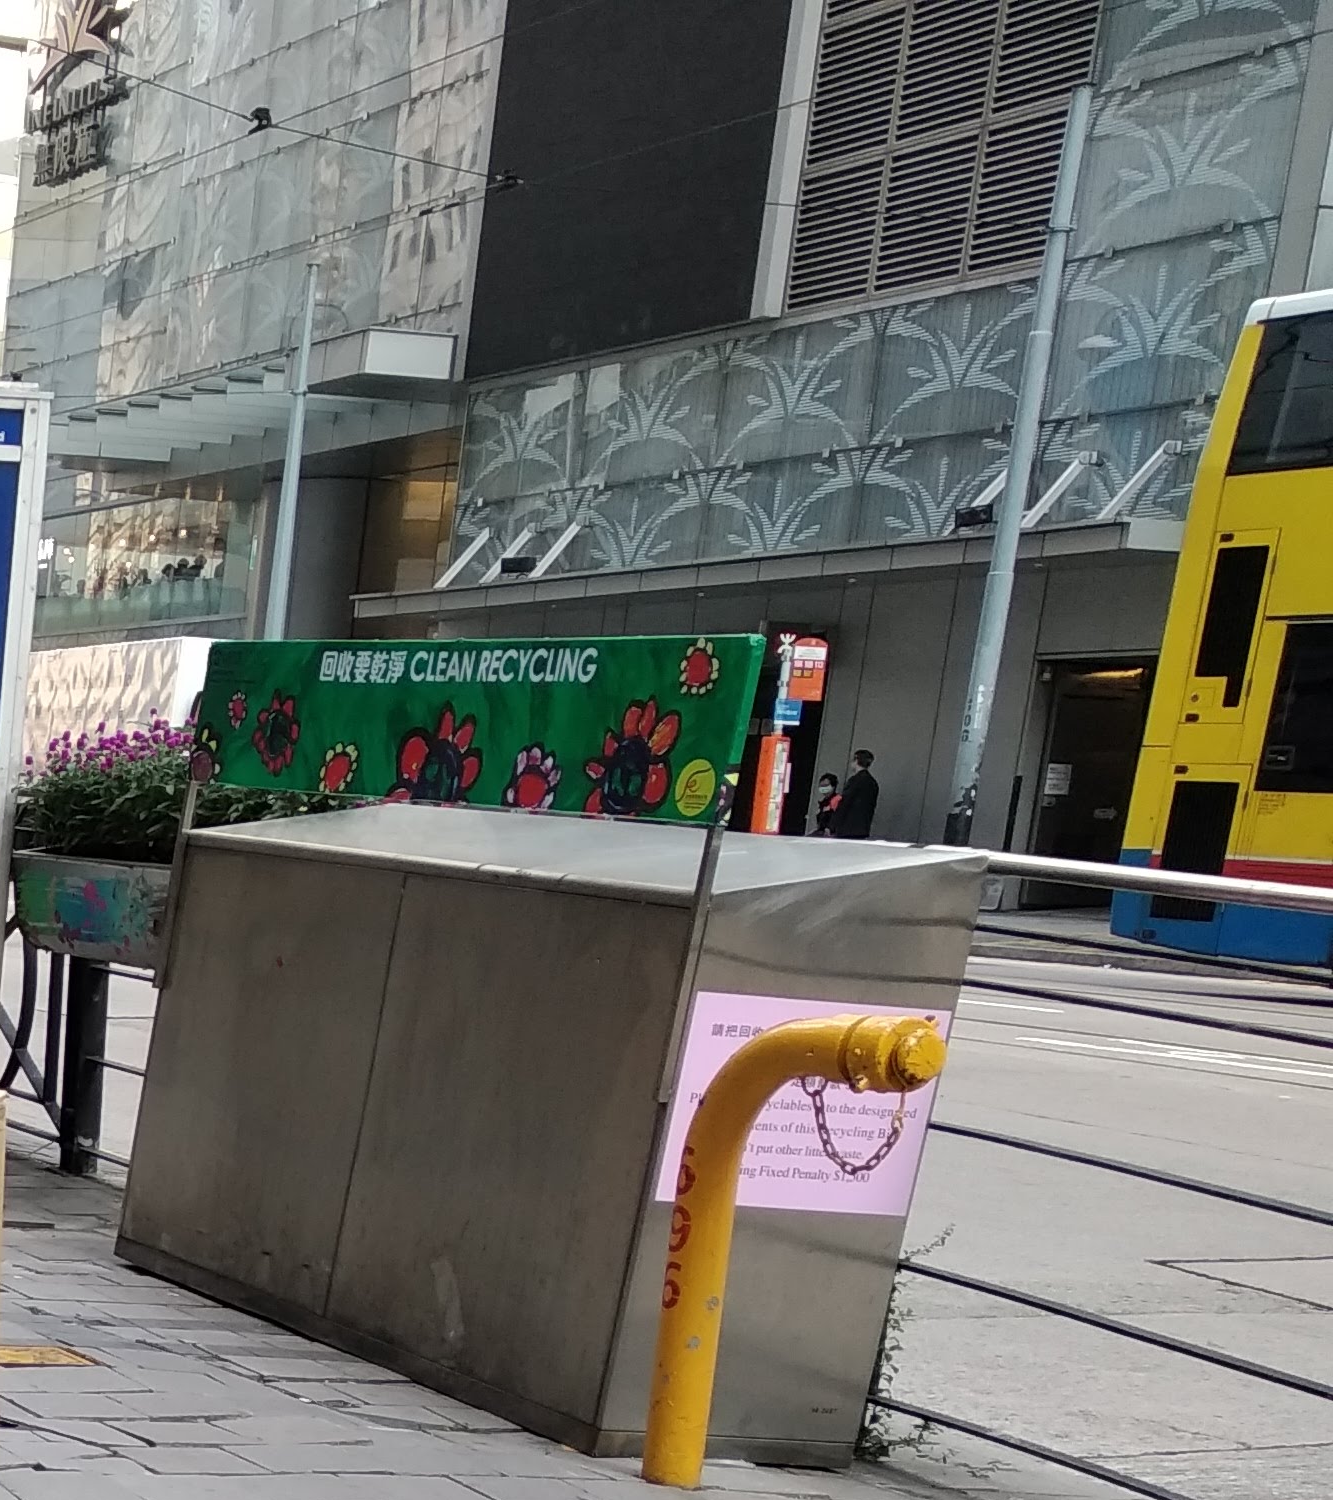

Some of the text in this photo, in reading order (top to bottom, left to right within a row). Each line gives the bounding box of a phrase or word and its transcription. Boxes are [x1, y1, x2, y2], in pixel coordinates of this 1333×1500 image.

[319, 650, 408, 684] 回收要乾淨
[409, 648, 599, 684] CLEAN RECYCLING
[826, 1103, 837, 1113] to
[839, 1104, 856, 1115] the
[780, 1121, 794, 1132] of
[795, 1123, 816, 1135] this
[756, 1144, 803, 1157] put other
[758, 1165, 789, 1178] Fixed
[791, 1167, 831, 1183] Penalty
